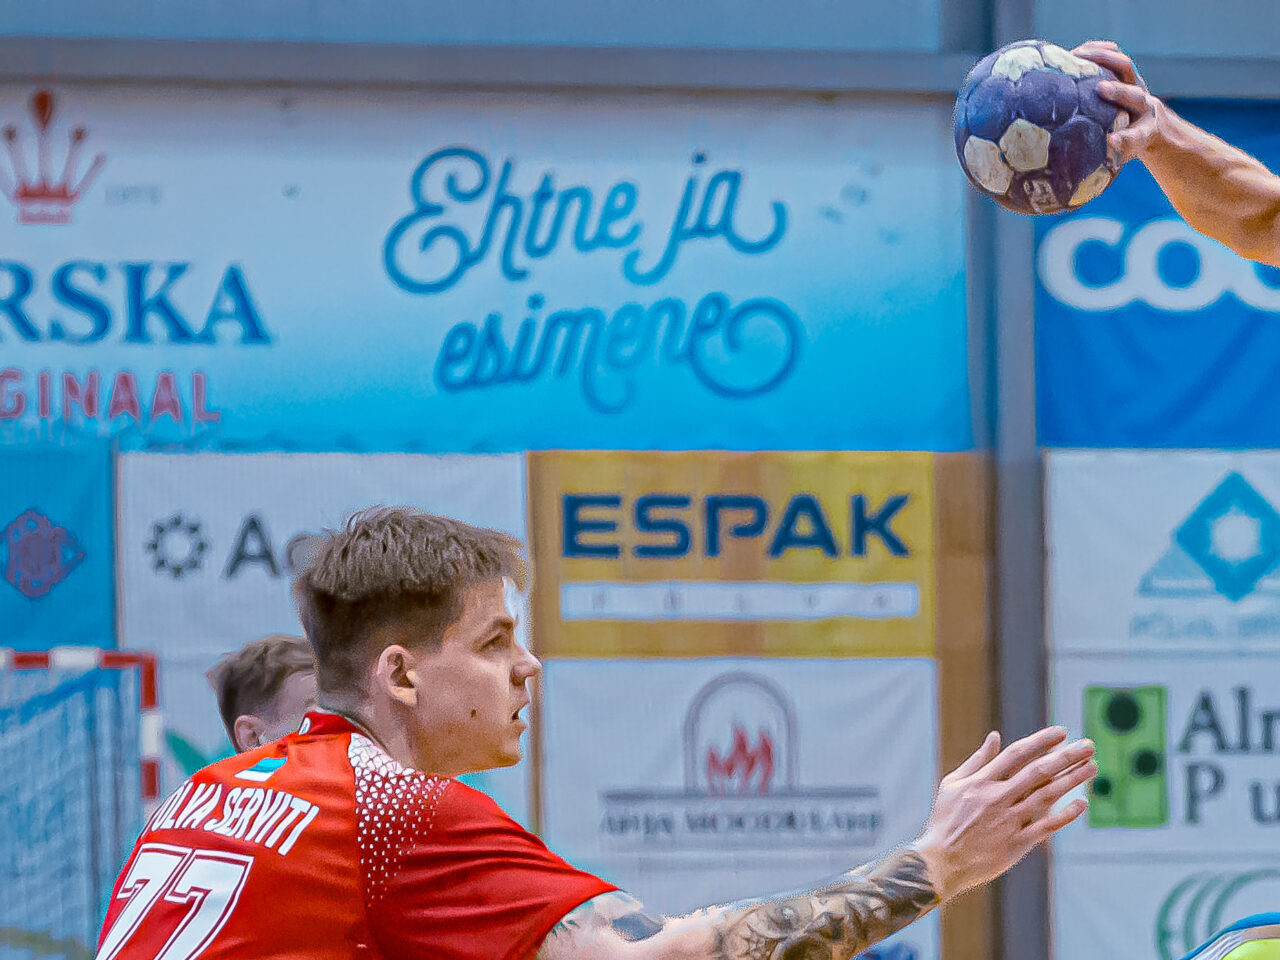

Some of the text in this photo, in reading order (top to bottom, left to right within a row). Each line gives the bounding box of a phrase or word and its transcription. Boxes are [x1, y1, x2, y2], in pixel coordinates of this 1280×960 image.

[382, 146, 786, 293] Ehtne ja
[433, 292, 801, 415] esimene
[562, 494, 911, 558] ESPAK
[203, 786, 320, 856] SERVITI
